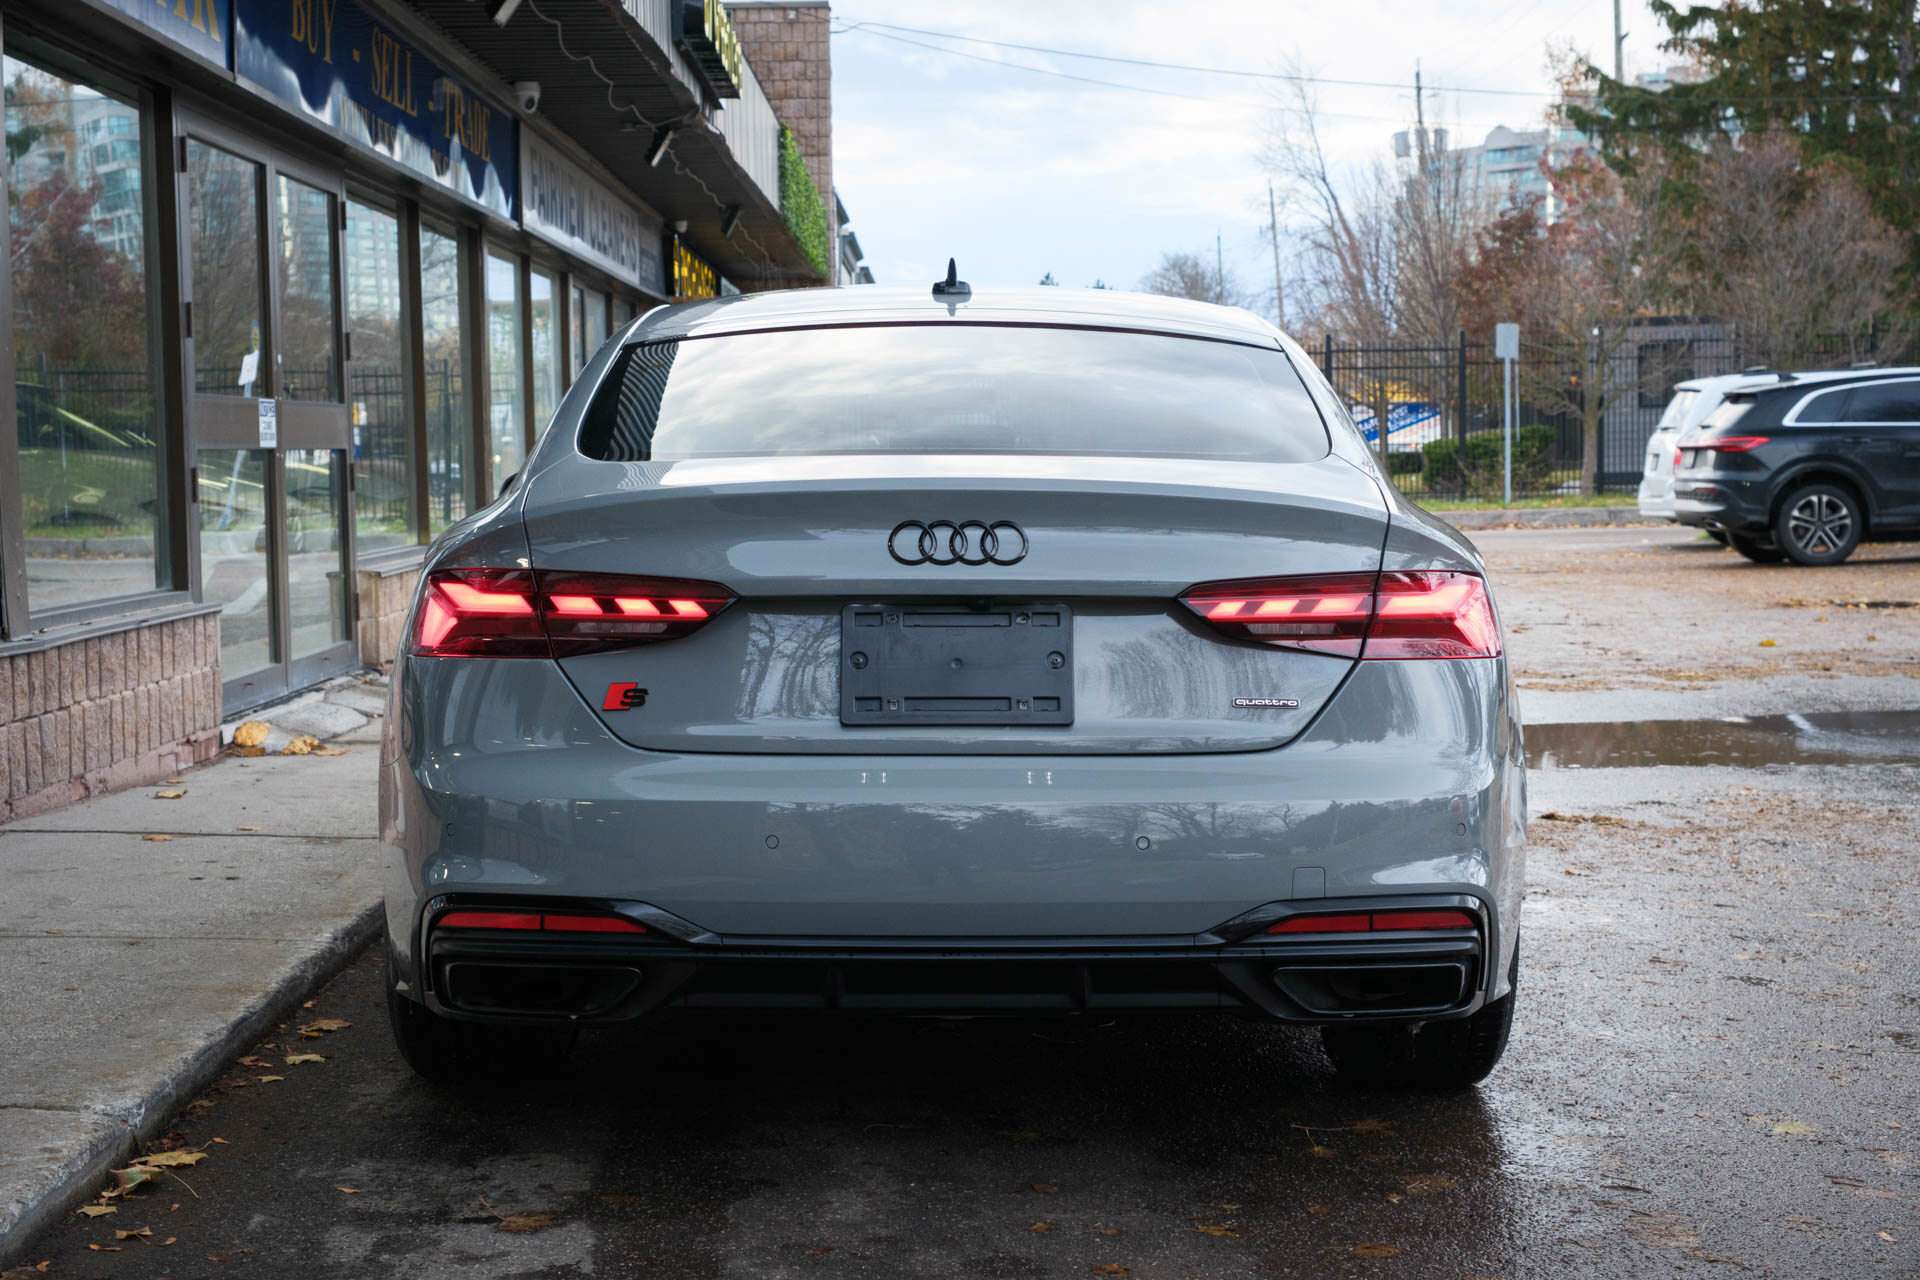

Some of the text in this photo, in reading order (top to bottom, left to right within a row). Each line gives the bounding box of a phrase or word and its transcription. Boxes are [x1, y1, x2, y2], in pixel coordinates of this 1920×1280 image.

[291, 0, 336, 64] BUY
[371, 26, 417, 117] SELL
[442, 79, 491, 161] TRADE
[1235, 698, 1298, 707] quattro
